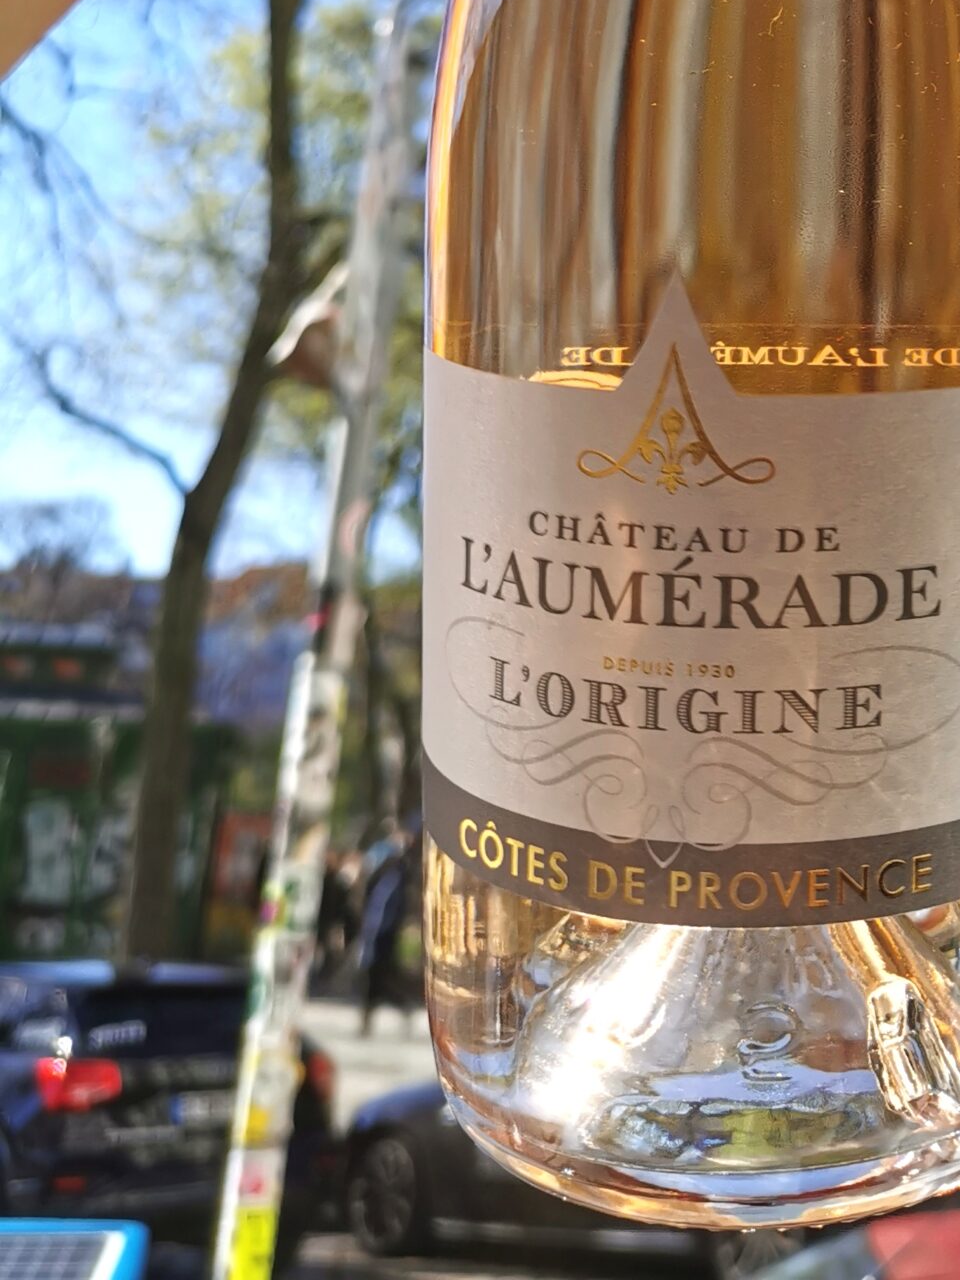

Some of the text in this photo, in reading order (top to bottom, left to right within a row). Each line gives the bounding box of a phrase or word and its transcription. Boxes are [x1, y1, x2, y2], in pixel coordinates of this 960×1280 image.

[528, 510, 842, 554] CHÂTEAU DE
[460, 535, 942, 629] L'AUMÉRADE
[488, 656, 883, 735] L'ORIGINE
[603, 656, 736, 679] DEPUIS 1930
[458, 817, 933, 911] CÔTES DE PROVENCE
